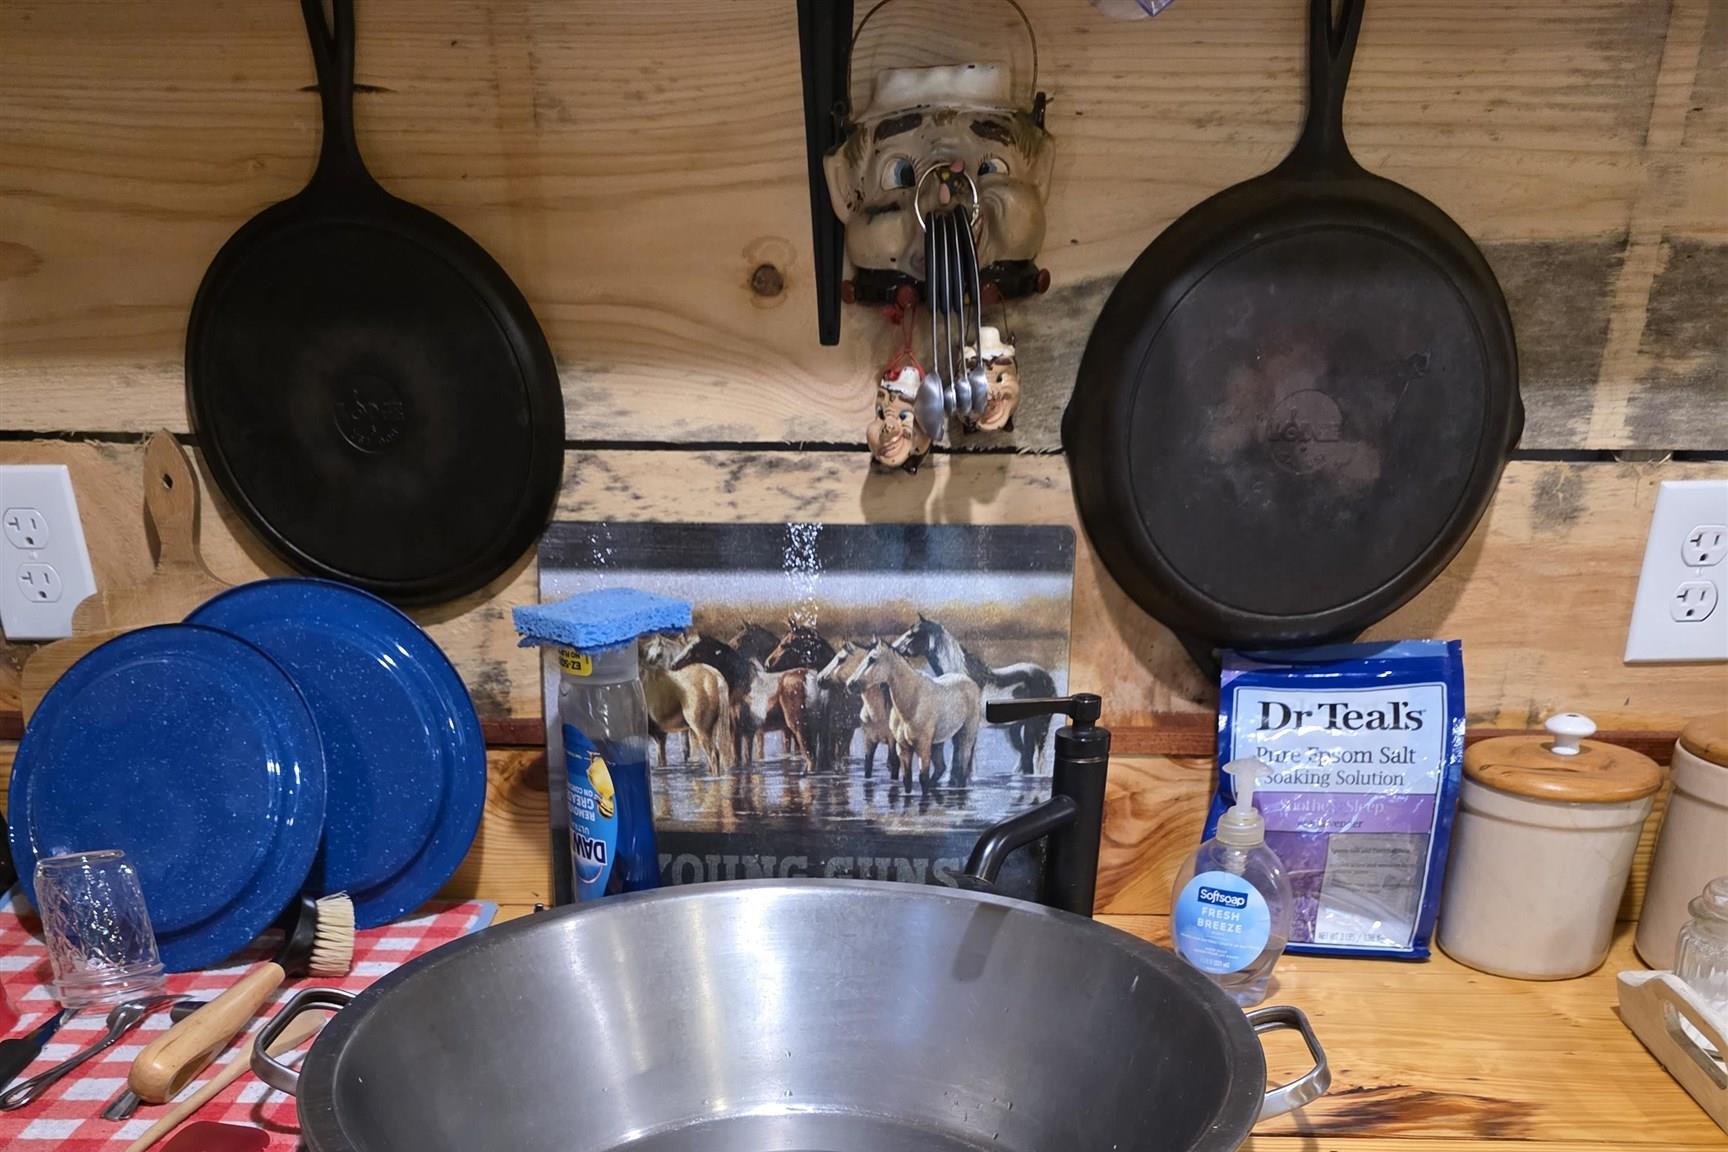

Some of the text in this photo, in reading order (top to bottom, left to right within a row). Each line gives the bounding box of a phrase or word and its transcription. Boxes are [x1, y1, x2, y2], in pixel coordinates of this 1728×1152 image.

[1256, 700, 1423, 731] Dr Teal's
[1379, 746, 1417, 764] Salt
[1264, 769, 1405, 788] Soaking Solution
[571, 832, 607, 865] DAW
[1199, 888, 1246, 907] Softsoap
[1200, 906, 1241, 922] FRESH
[1196, 917, 1244, 934] BREEZE
